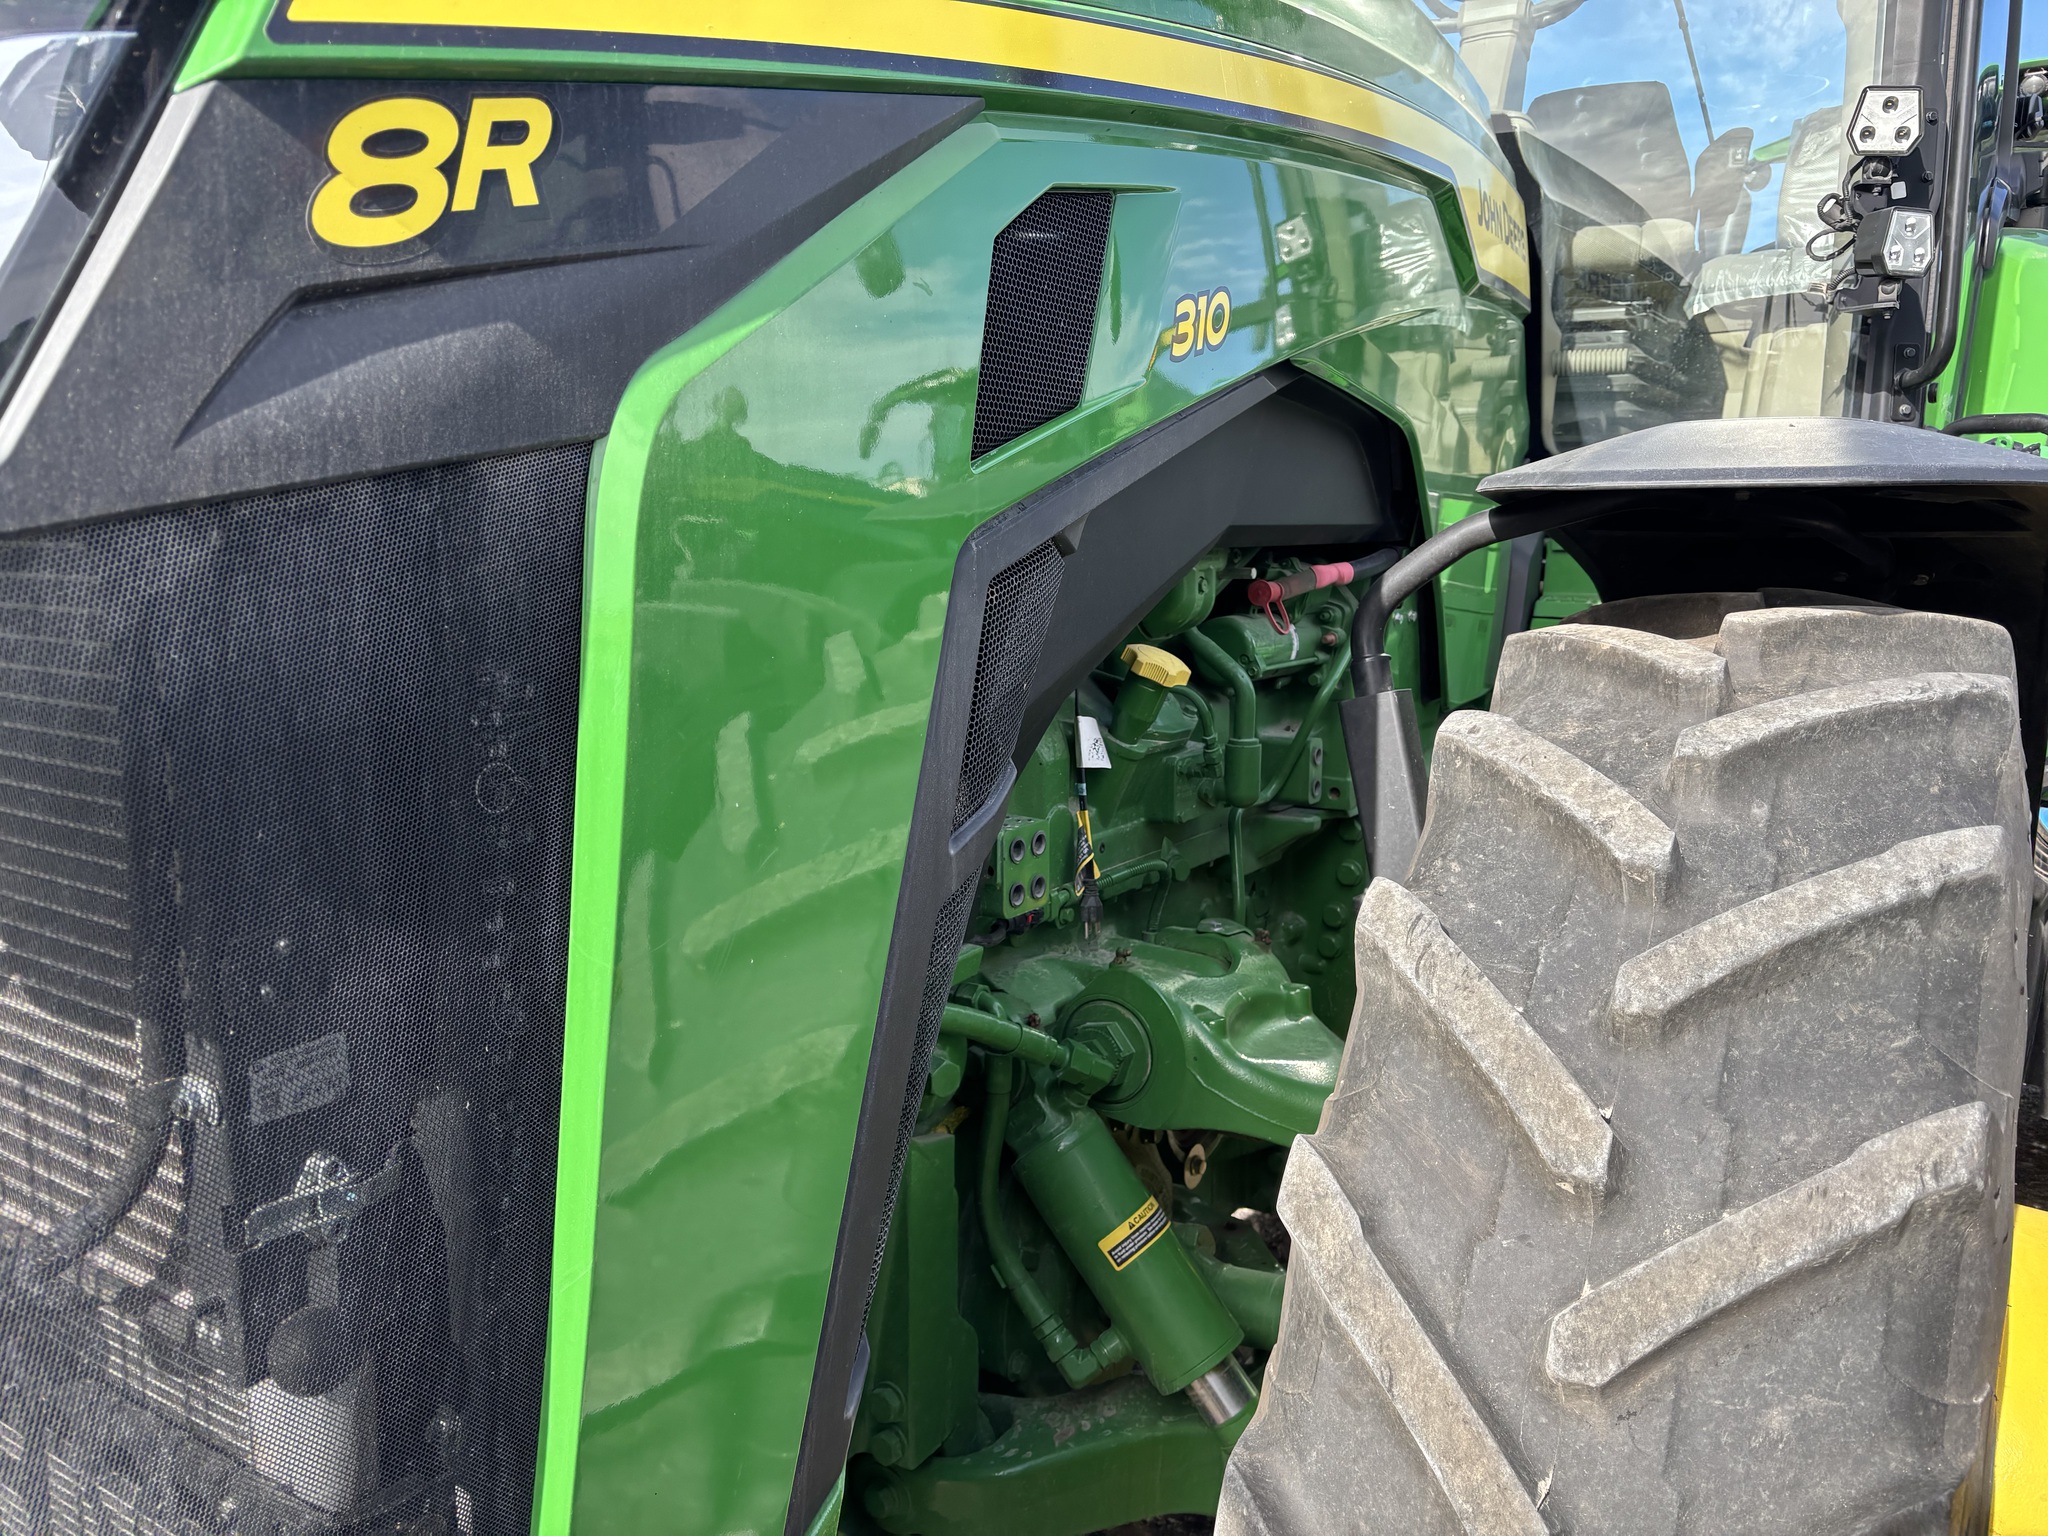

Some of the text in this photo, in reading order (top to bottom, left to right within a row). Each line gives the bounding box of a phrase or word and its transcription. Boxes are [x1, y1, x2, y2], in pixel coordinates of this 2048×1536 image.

[312, 97, 552, 247] 8R
[1477, 178, 1503, 241] JOHN
[1170, 288, 1231, 361] 310
